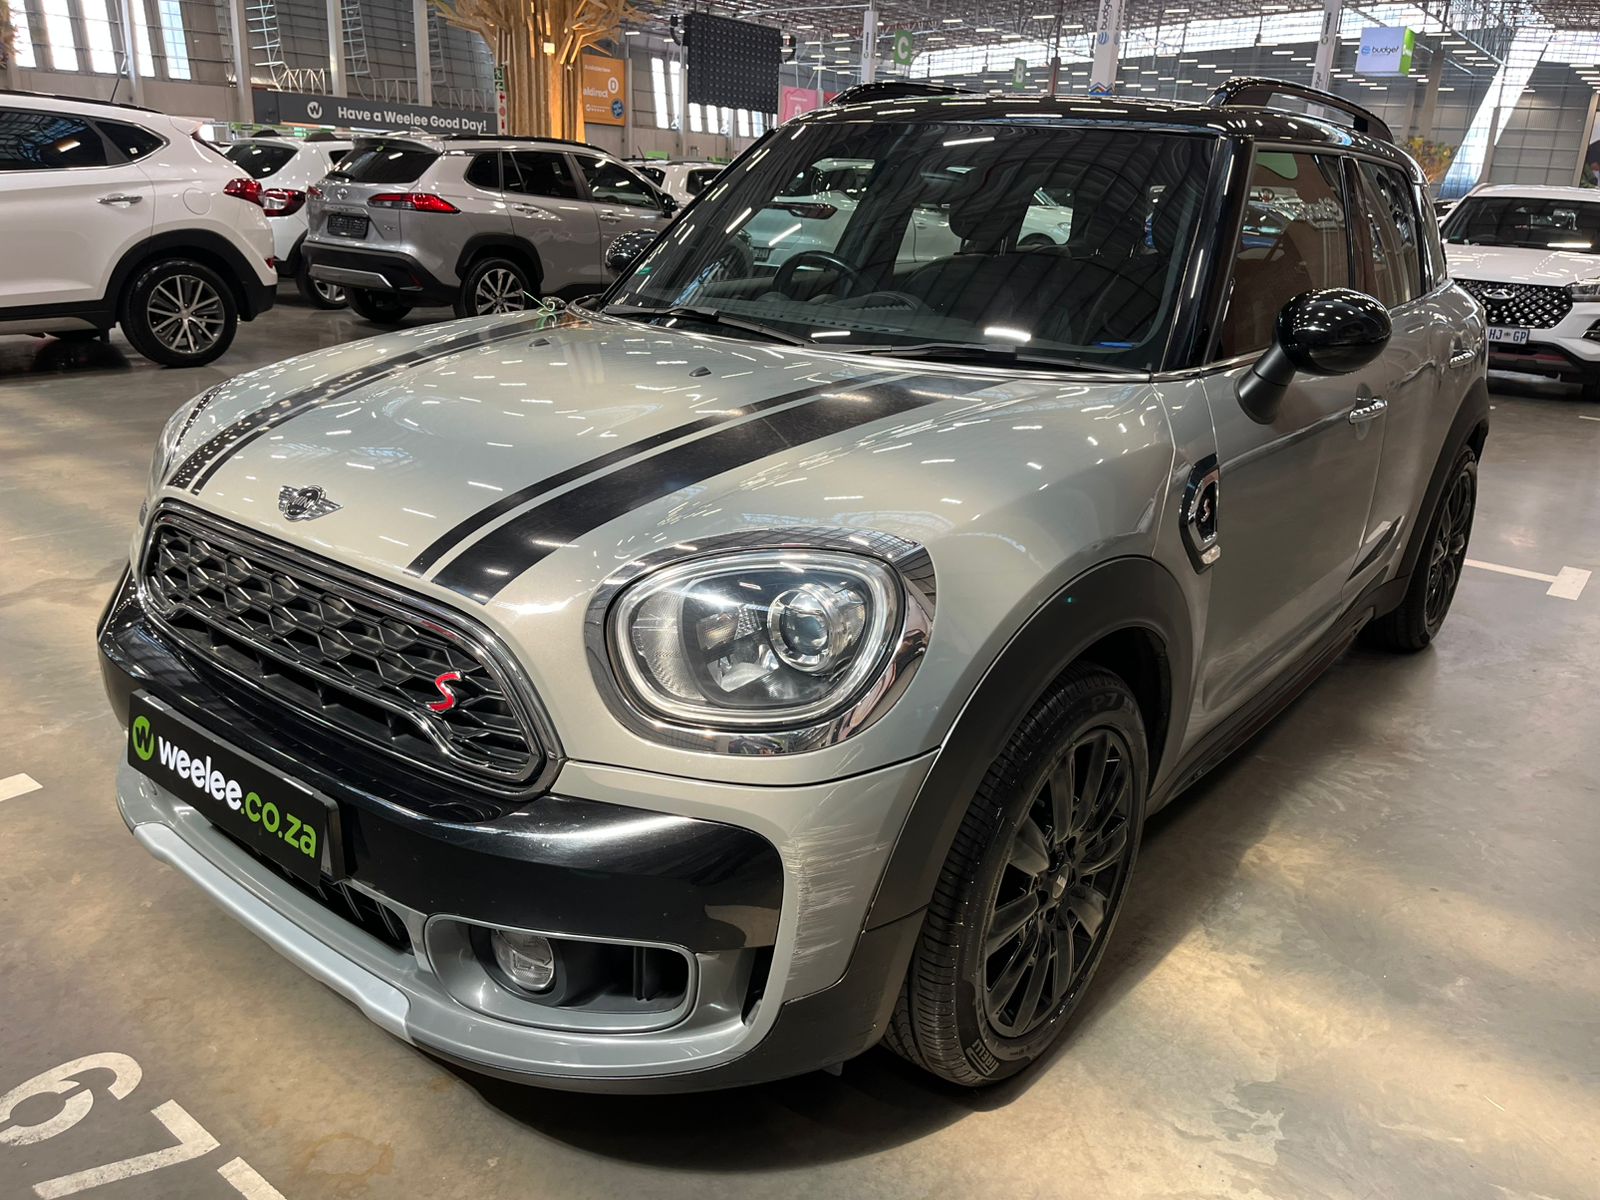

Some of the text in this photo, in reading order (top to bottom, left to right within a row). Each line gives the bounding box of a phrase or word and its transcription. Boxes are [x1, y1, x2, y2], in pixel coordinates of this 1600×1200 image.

[897, 36, 910, 60] C
[1371, 45, 1400, 56] budget
[337, 105, 370, 121] Have
[373, 112, 382, 122] a
[383, 110, 428, 127] Weelee
[429, 115, 460, 129] Good
[461, 117, 487, 133] Day!
[1488, 329, 1527, 342] HJ GP
[425, 670, 463, 715] S
[157, 735, 318, 859] weelee.co.za
